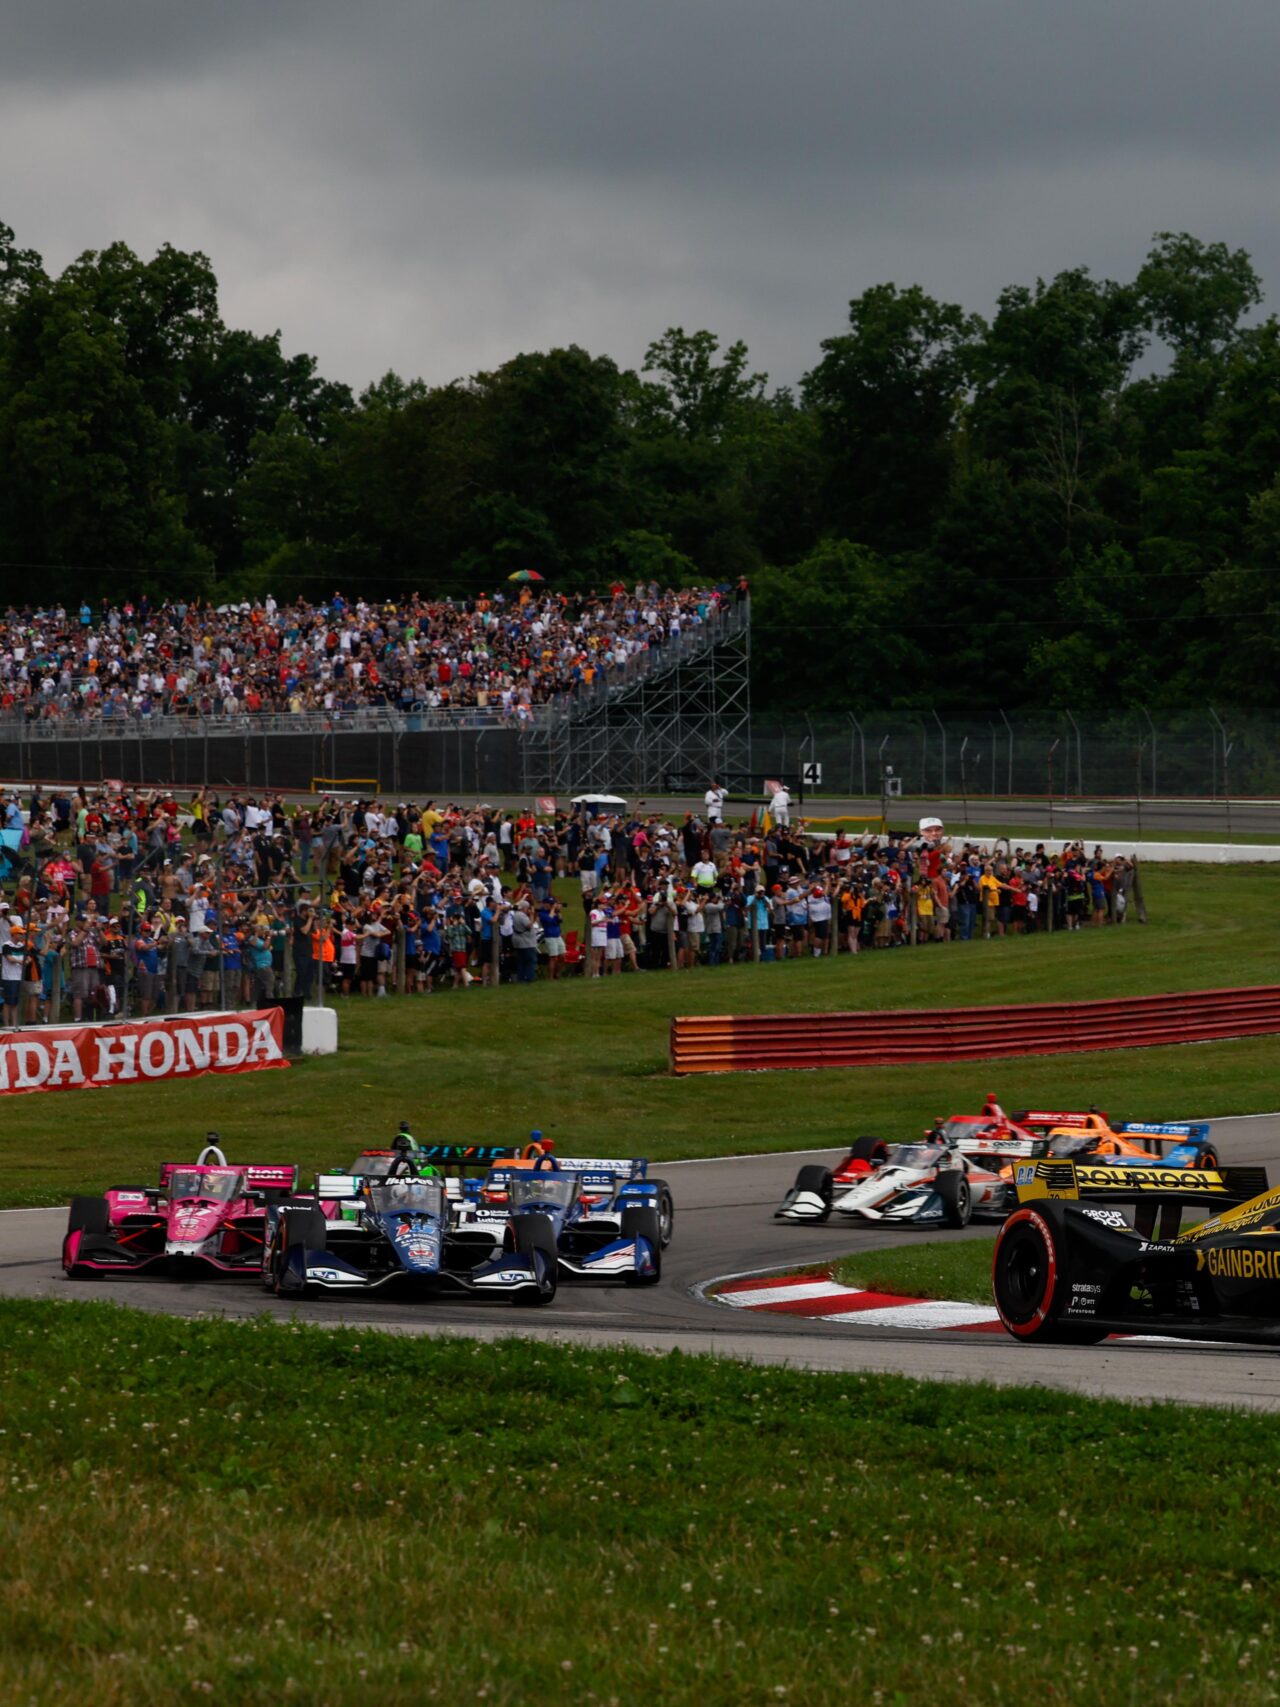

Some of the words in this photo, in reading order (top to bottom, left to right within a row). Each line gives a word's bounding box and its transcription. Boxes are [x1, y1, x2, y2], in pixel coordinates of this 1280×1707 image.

[805, 764, 819, 783] 4
[0, 1039, 86, 1090] DA
[92, 1020, 283, 1082] HONDA
[1082, 1209, 1122, 1219] GROUP
[1148, 1243, 1175, 1253] ZAPATA
[1072, 1284, 1101, 1293] stratasys
